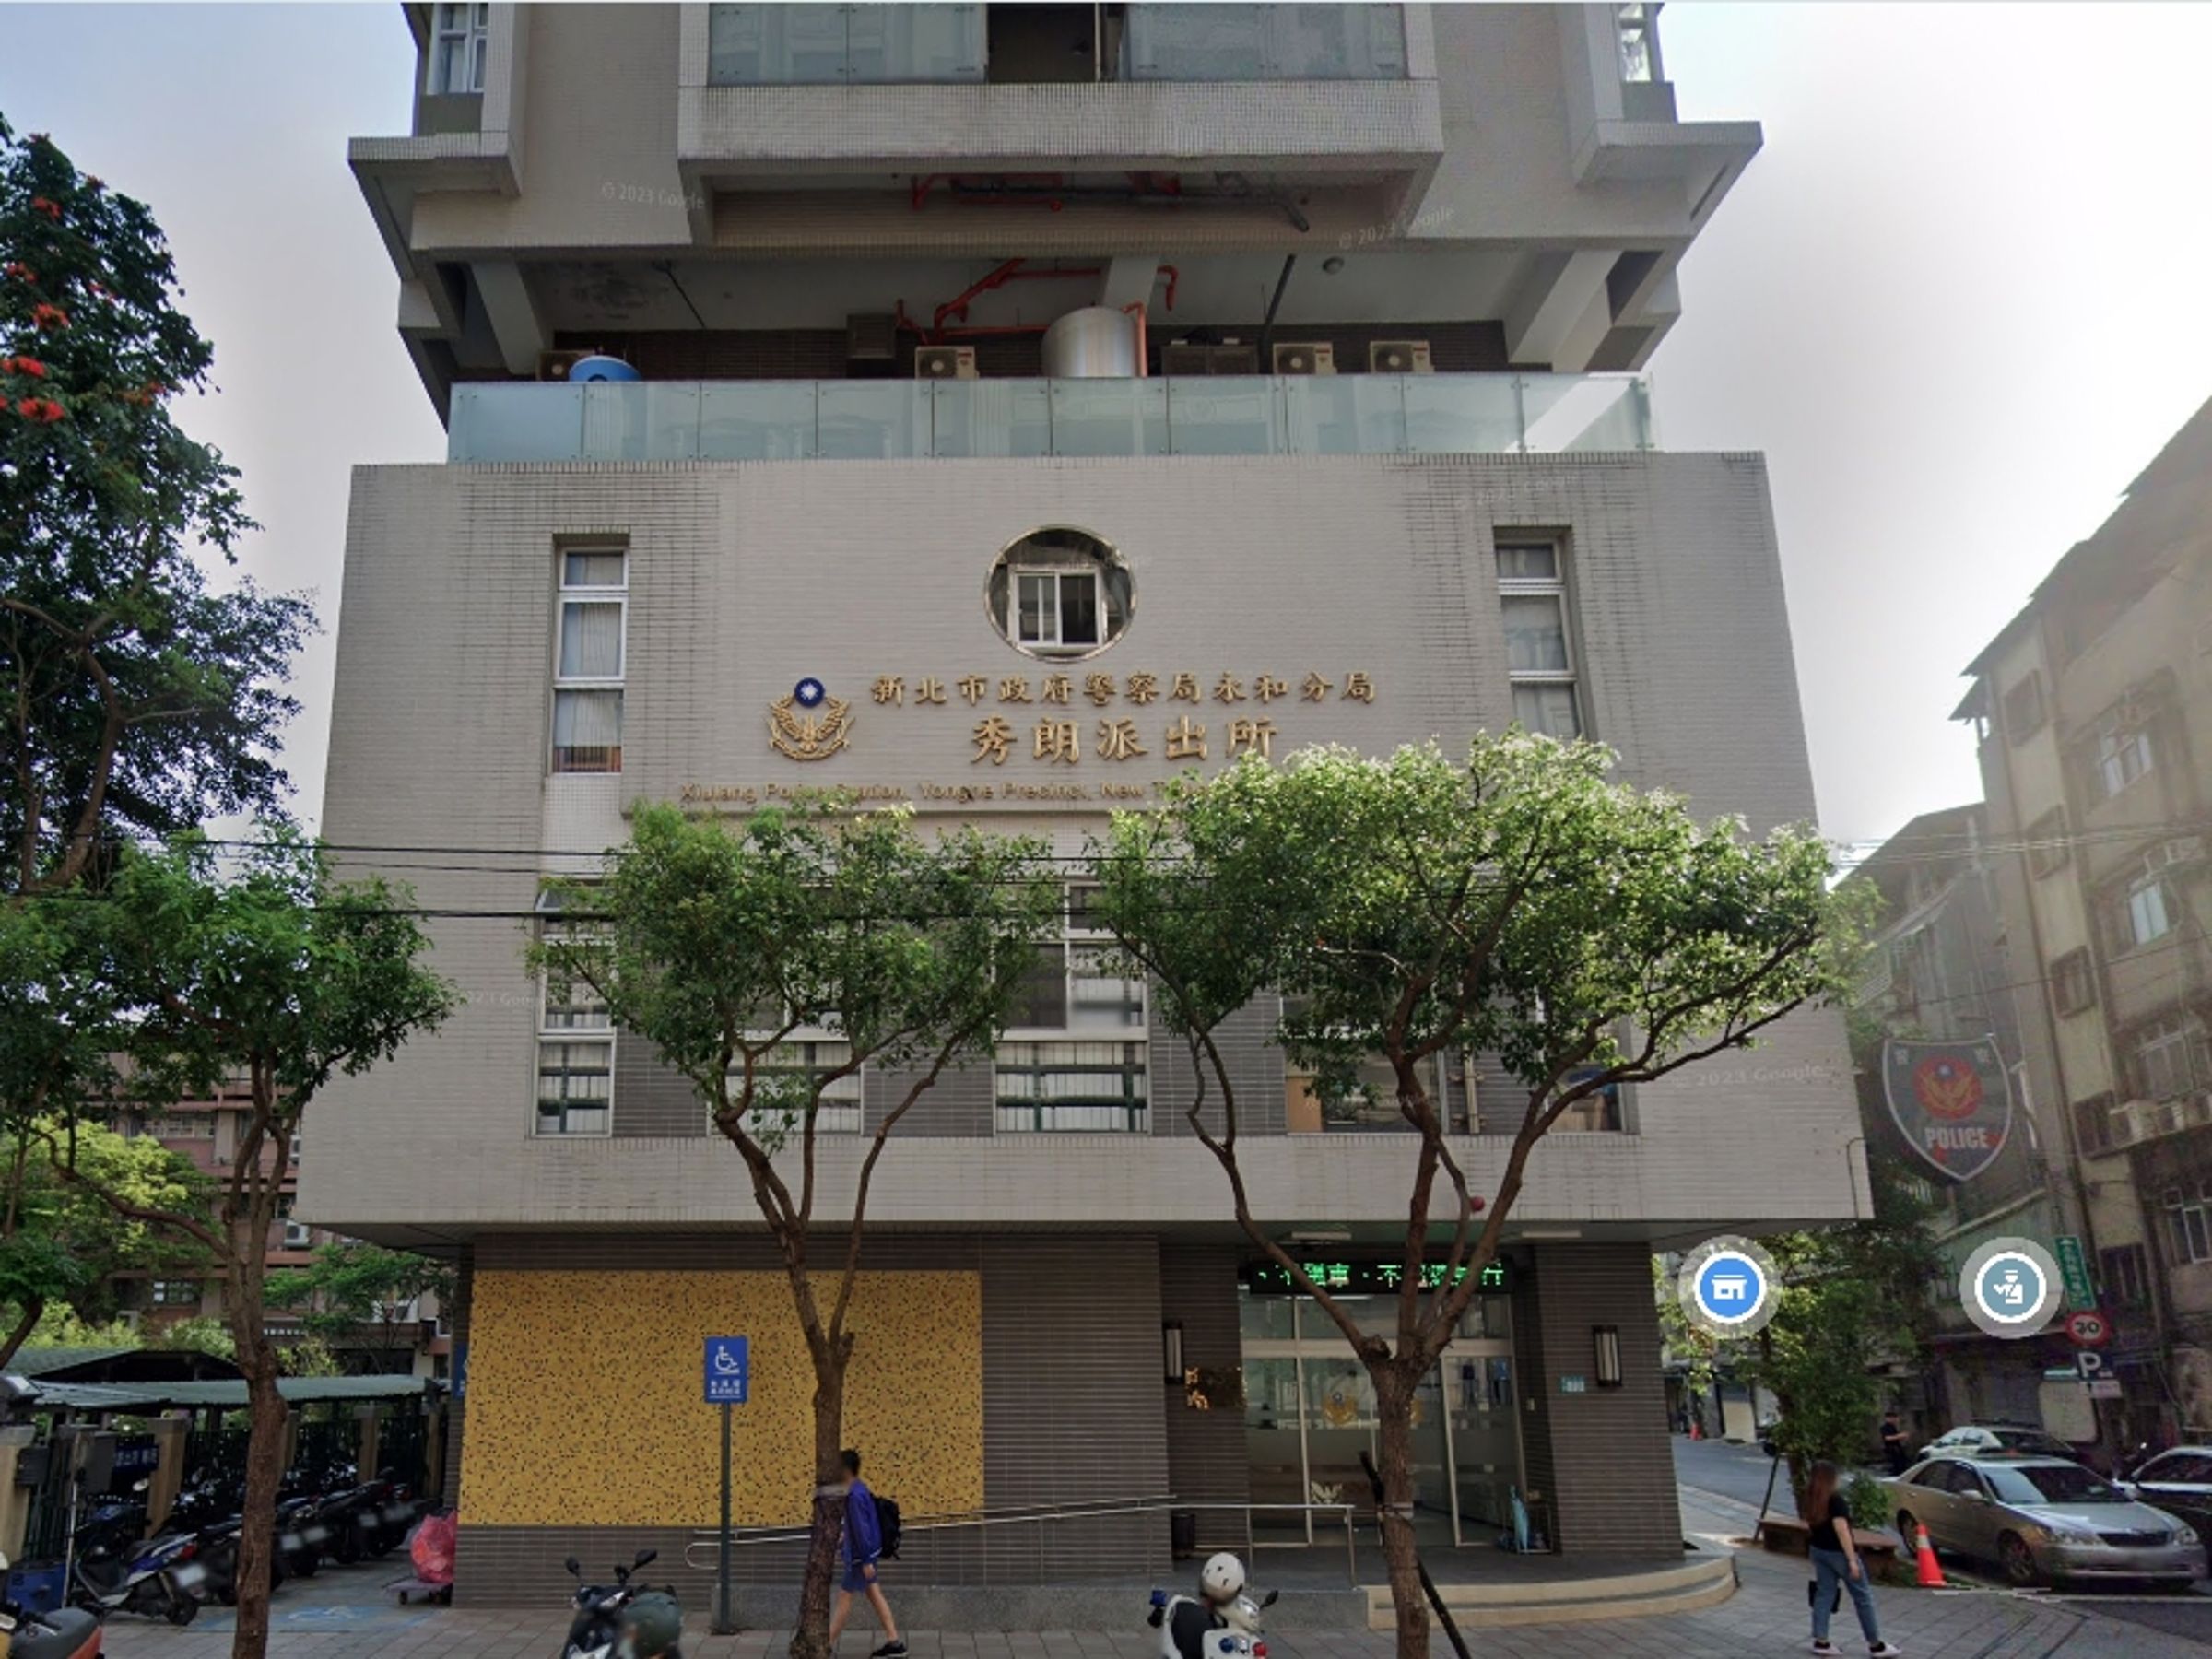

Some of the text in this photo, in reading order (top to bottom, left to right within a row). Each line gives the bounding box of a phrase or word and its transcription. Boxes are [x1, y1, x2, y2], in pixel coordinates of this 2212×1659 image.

[871, 673, 1375, 708] 新北市政府警察局永和分局
[971, 714, 1277, 765] 秀朗派出所
[681, 782, 757, 803] Xiulang
[1100, 781, 1144, 799] New
[1924, 1126, 1988, 1150] POLICE
[2077, 1351, 2102, 1379] P
